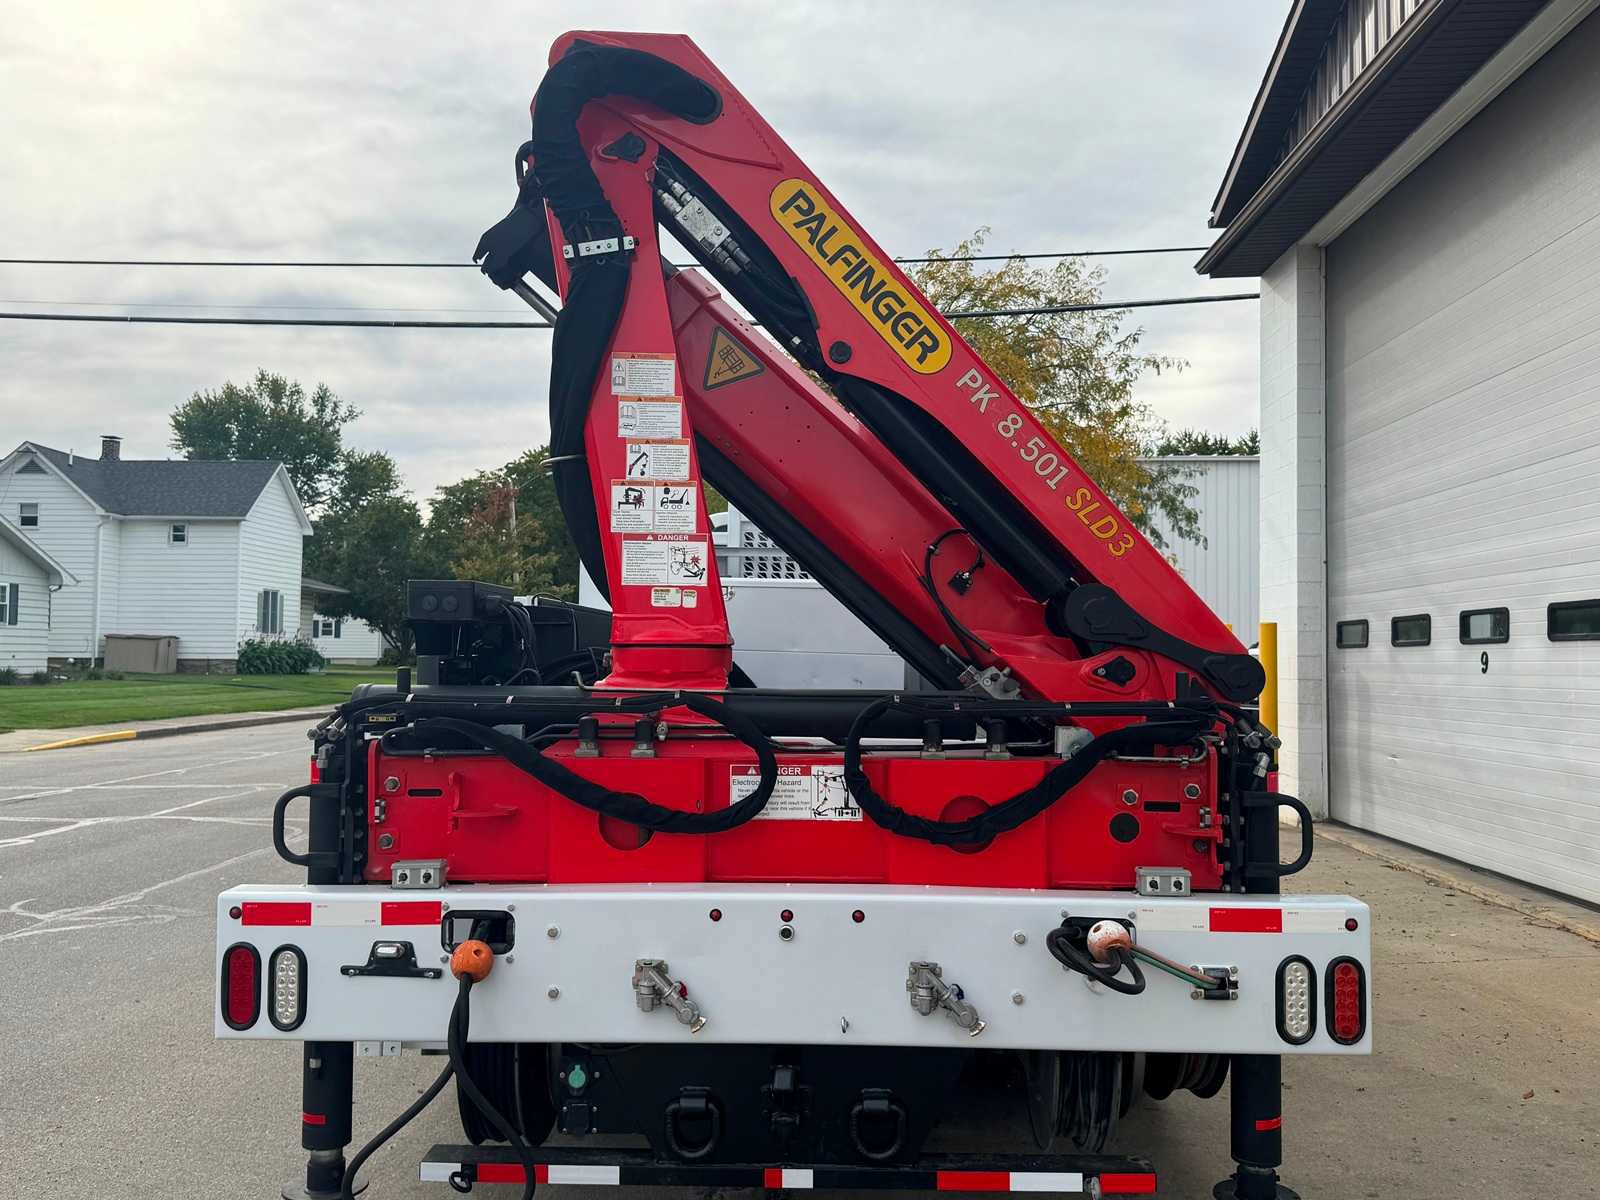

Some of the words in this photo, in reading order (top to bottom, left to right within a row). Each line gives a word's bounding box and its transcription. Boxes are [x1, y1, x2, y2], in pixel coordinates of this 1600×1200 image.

[779, 188, 939, 365] PALFINGER
[956, 367, 1000, 414] PK
[997, 413, 1069, 490] 8.501
[1065, 487, 1135, 557] SLD3
[1480, 651, 1489, 674] 9
